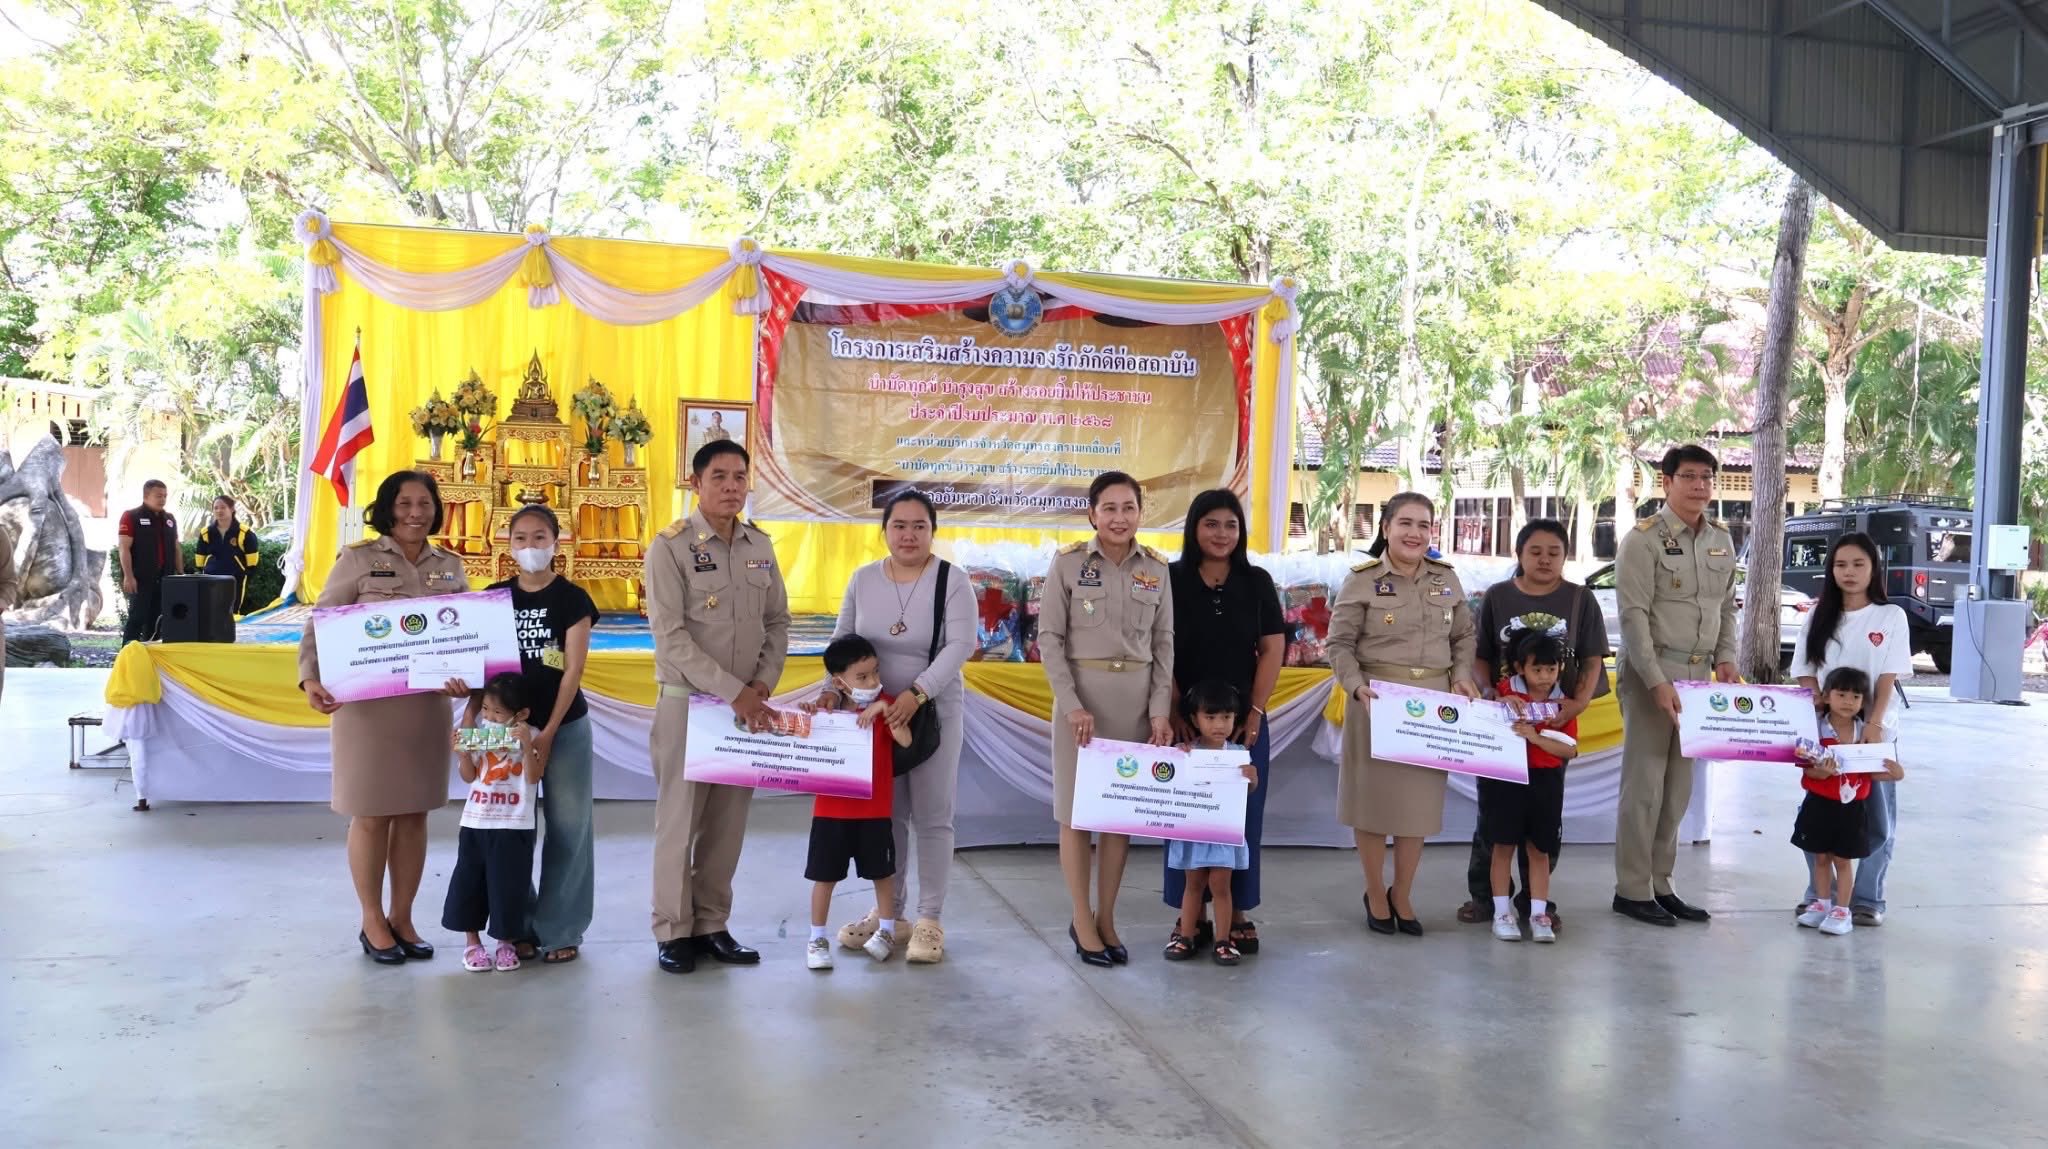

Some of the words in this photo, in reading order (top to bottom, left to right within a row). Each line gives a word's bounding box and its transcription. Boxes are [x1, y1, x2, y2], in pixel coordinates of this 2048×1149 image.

[829, 330, 1196, 376] โครงการเสริมสร้างความจงรักภักดีต่อสถาบัน
[548, 653, 560, 667] 26
